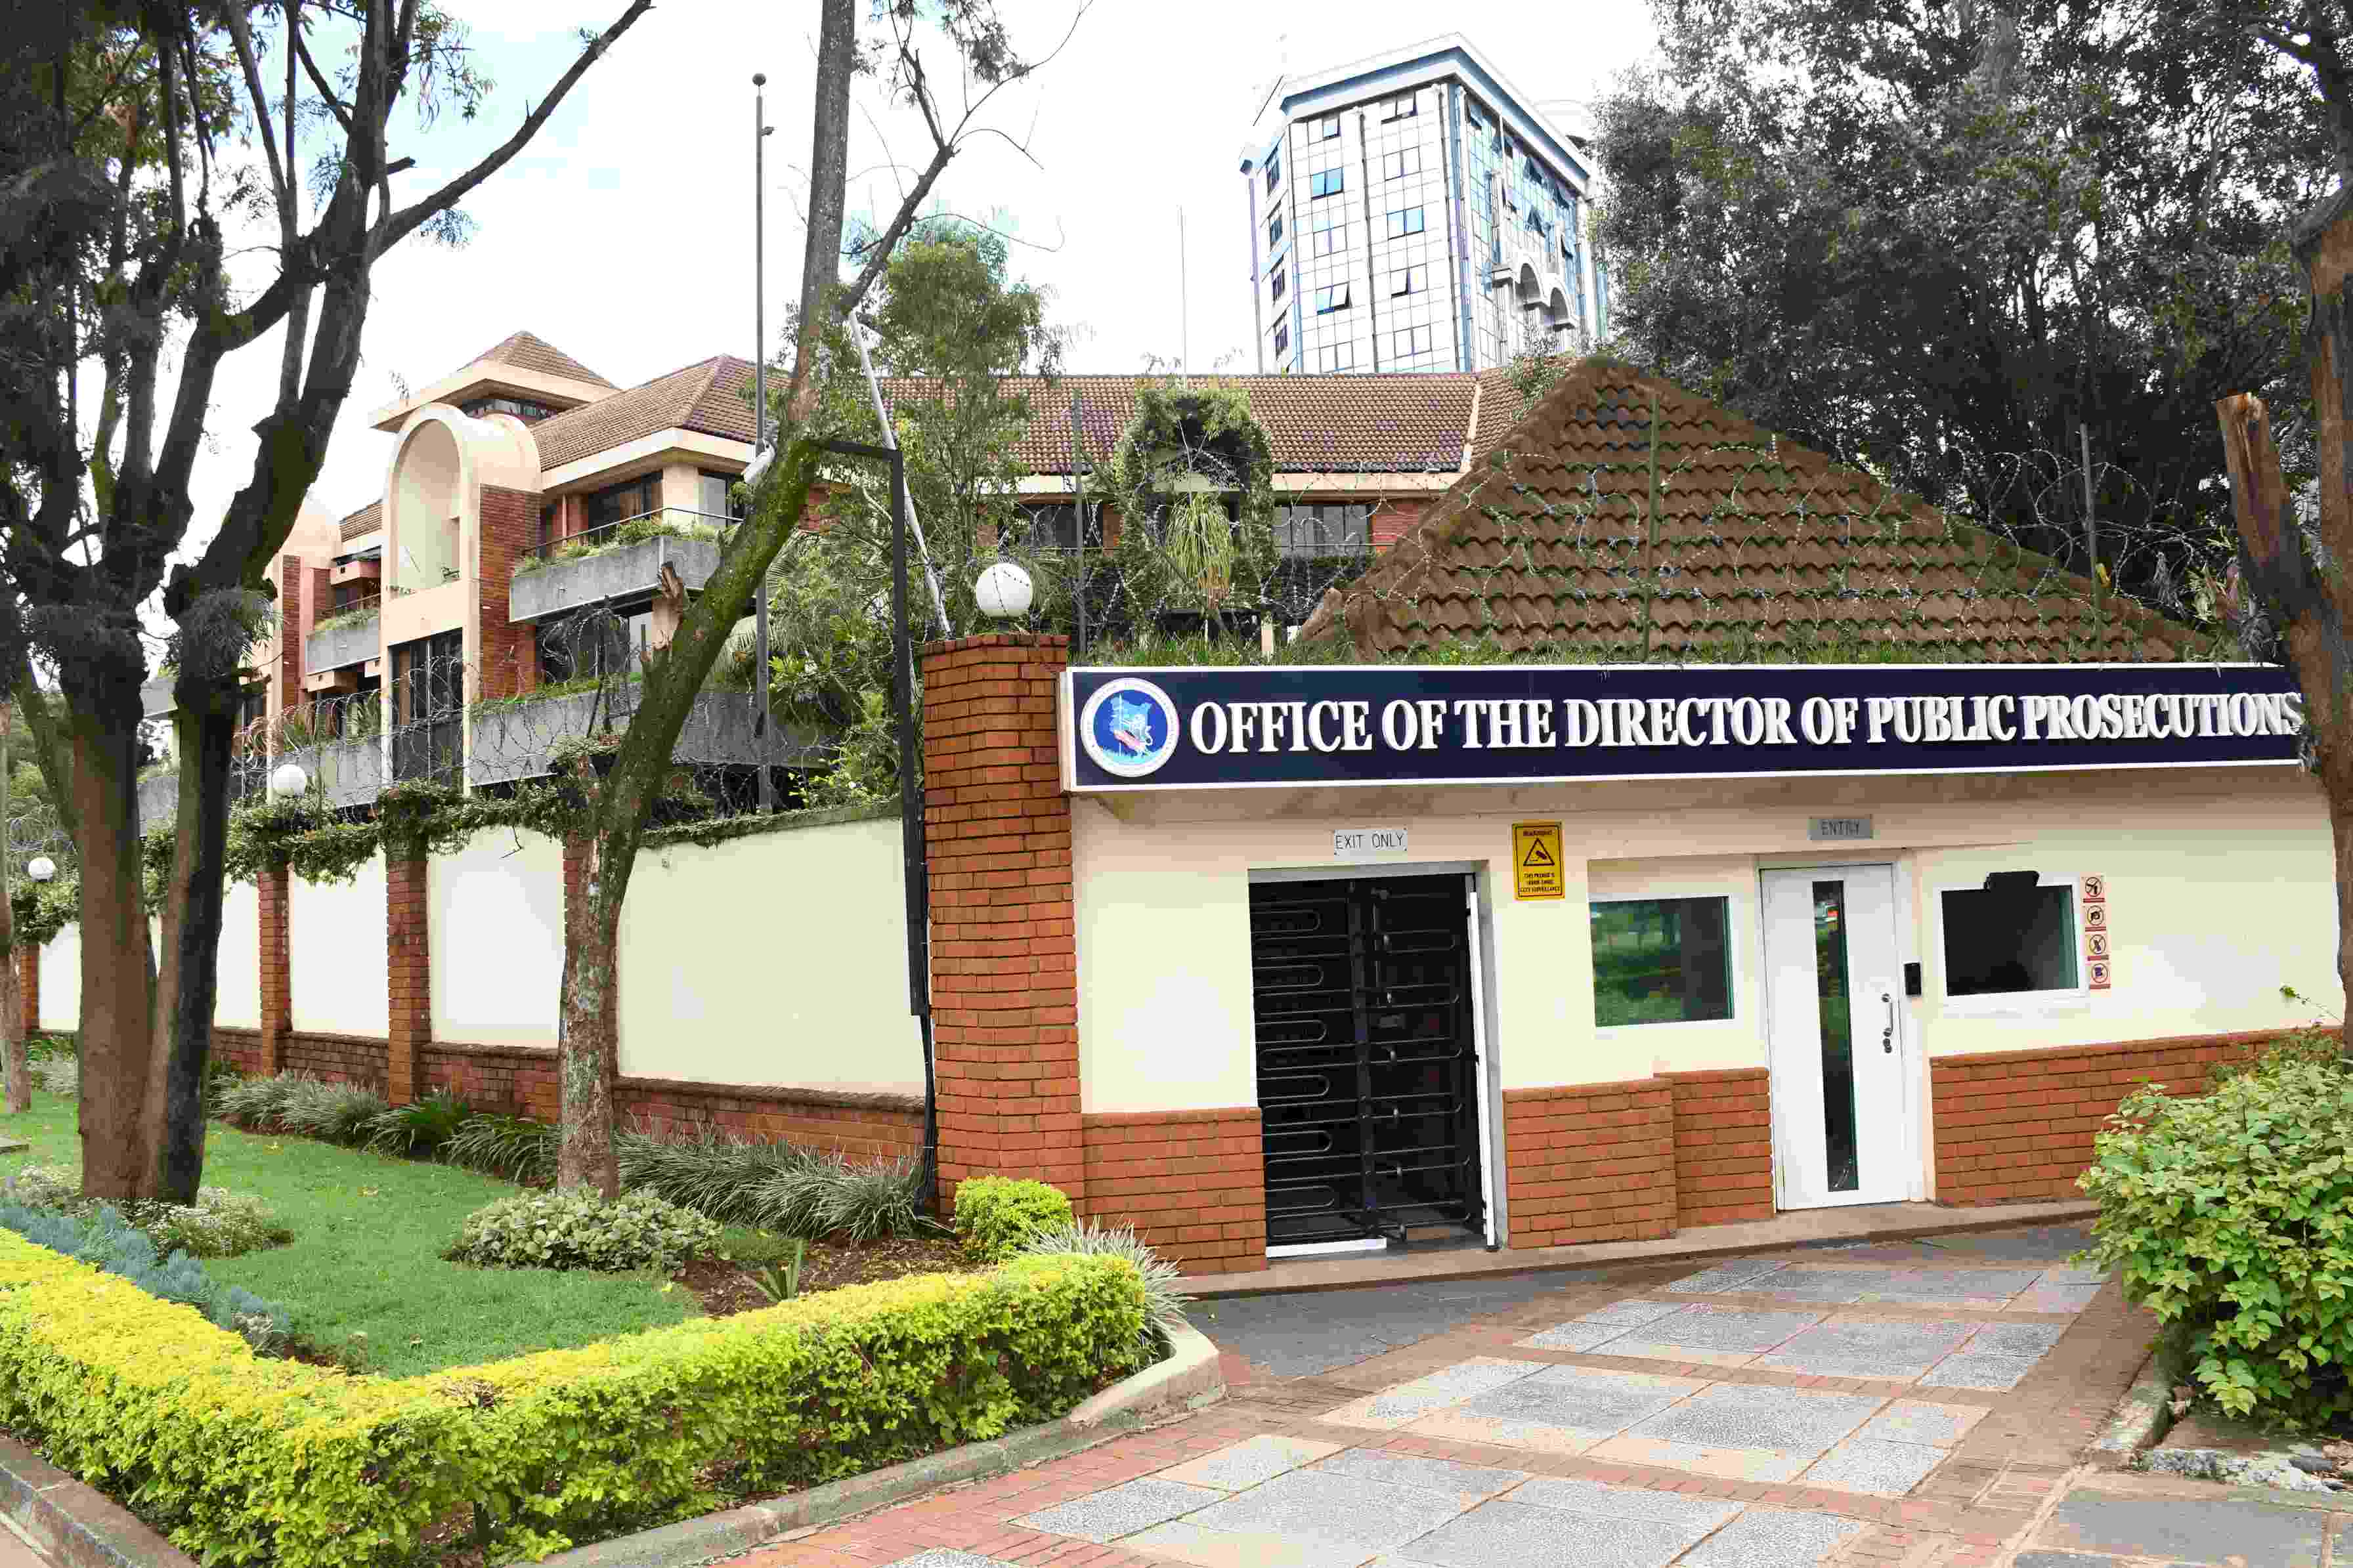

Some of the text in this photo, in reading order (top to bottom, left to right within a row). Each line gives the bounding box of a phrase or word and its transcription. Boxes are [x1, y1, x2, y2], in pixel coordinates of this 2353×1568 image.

[1190, 701, 1373, 753] OFFICE
[1381, 700, 1447, 750] OF
[1454, 699, 1556, 748] THE
[1563, 697, 1798, 747] DIRECTOR
[1801, 697, 1859, 746] OF
[1864, 695, 2017, 743] PUBLIC
[2021, 692, 2302, 740] PROSECUTIONS
[1821, 819, 1859, 836] ENTRY
[1335, 833, 1404, 849] EXIT ONLY
